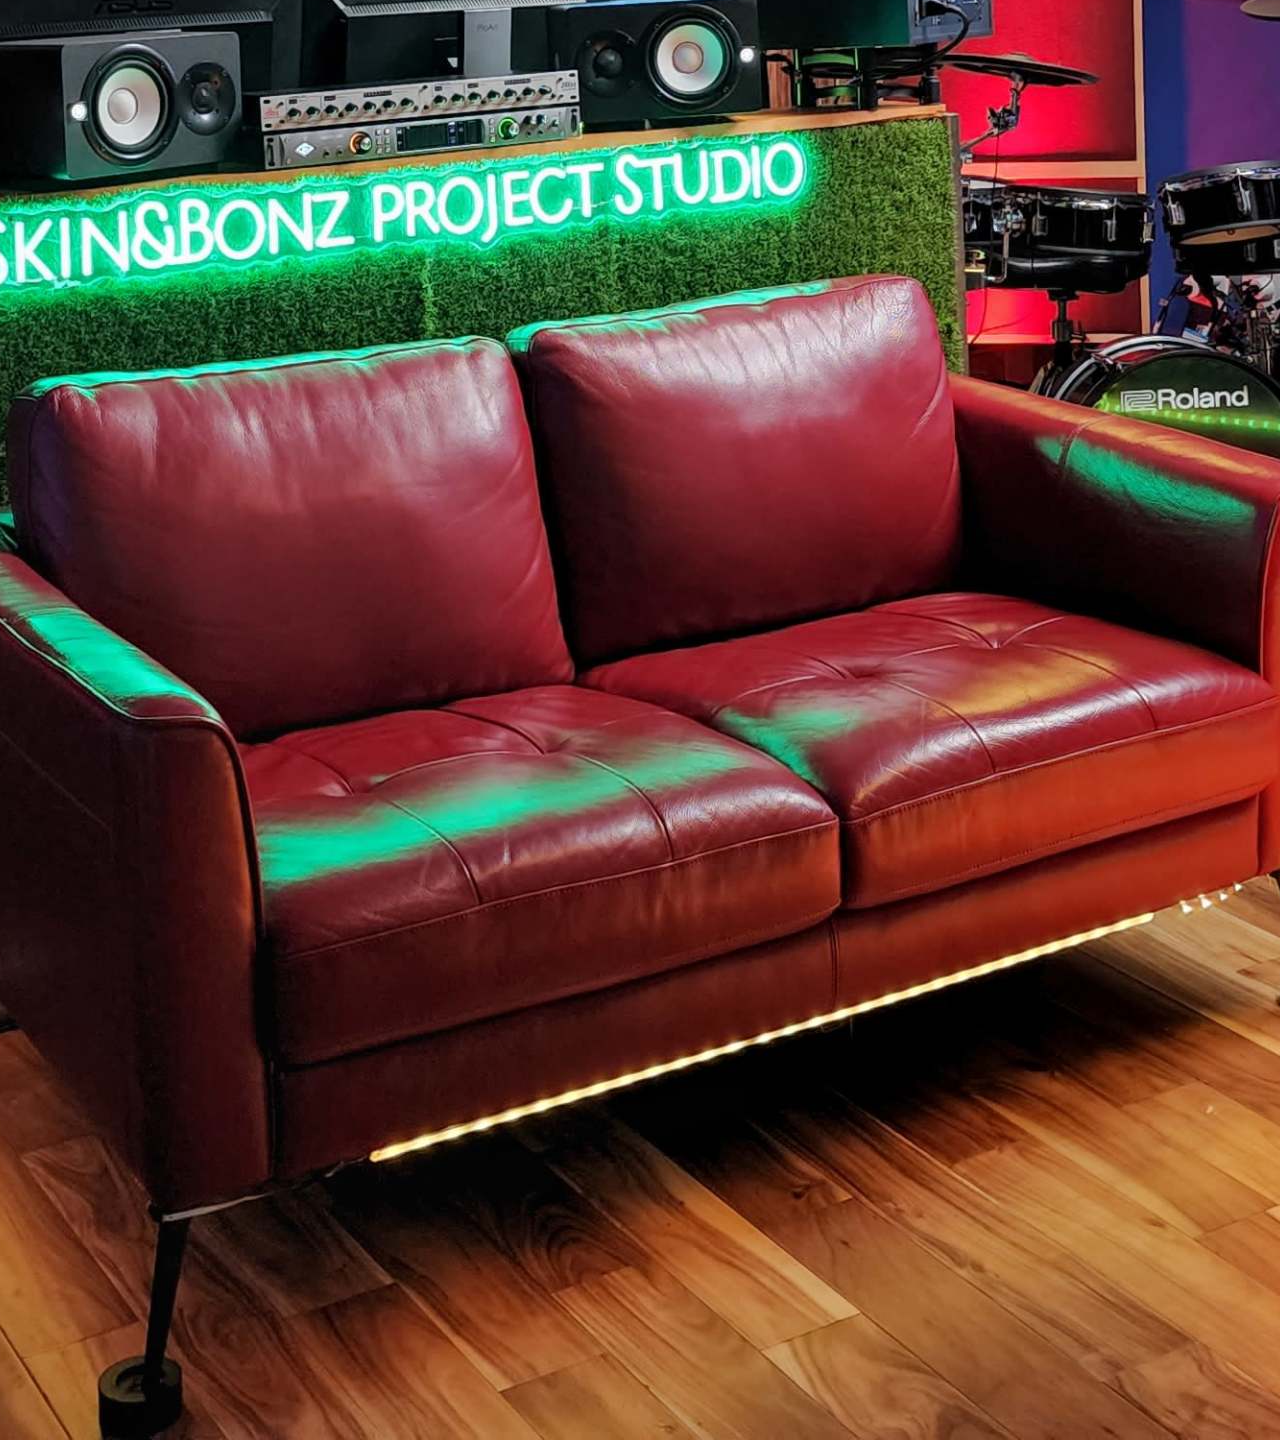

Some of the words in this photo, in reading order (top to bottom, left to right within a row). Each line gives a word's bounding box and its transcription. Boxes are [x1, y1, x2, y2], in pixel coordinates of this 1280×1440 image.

[373, 160, 604, 244] PROJECT
[614, 139, 806, 215] STUDIO
[1157, 385, 1249, 410] Roland
